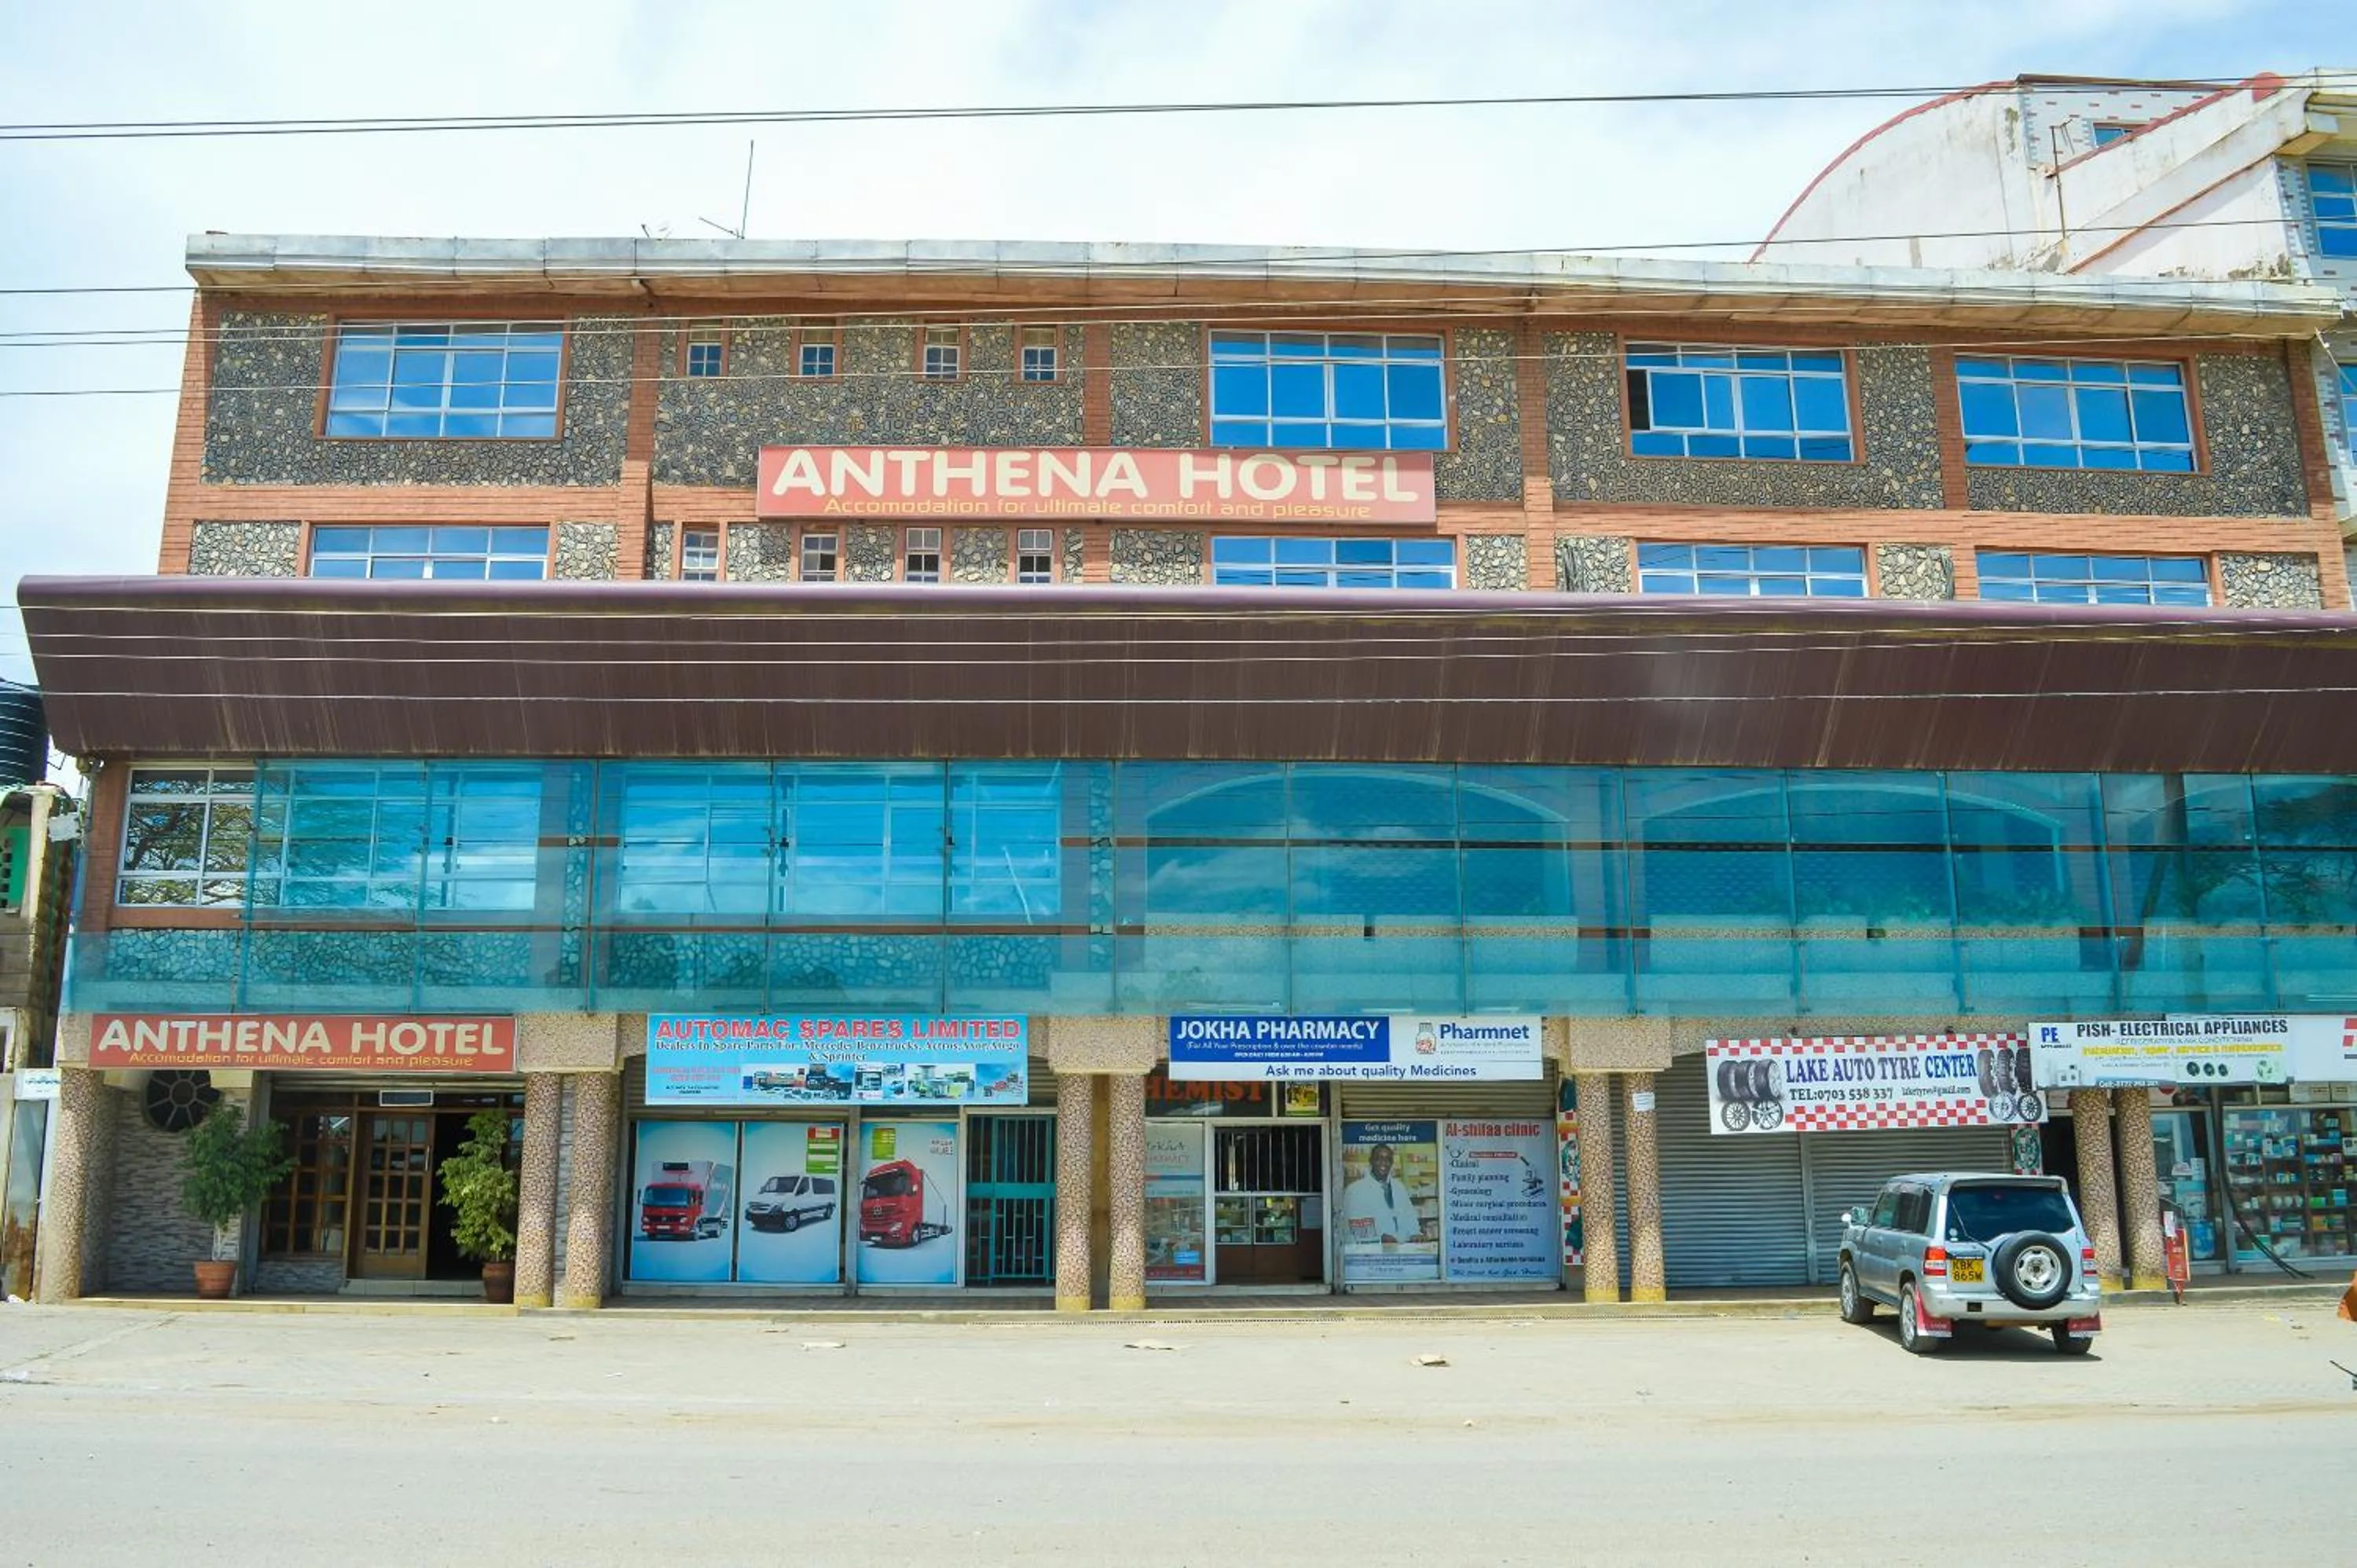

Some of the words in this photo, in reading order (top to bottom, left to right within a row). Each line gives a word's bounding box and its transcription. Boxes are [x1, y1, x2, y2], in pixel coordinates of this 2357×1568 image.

[772, 449, 1149, 499] ANTHENA
[1179, 453, 1419, 502] HOTEL
[823, 498, 989, 514] Accomodation
[997, 498, 1028, 515] for
[1035, 498, 1122, 515] ultimate
[1131, 500, 1211, 516] comfort
[1221, 500, 1264, 517] and
[1273, 500, 1372, 519] pleasure
[656, 1018, 790, 1039] AUTOMAC
[799, 1018, 903, 1039] SPARES
[911, 1018, 1021, 1039] LIMITED
[1177, 1020, 1251, 1040] JOKHA
[1257, 1020, 1380, 1039] PHARMACY
[1439, 1023, 1530, 1039] Pharmnet
[2040, 1027, 2059, 1043] PE
[2077, 1023, 2117, 1038] PISH-
[2121, 1020, 2201, 1037] ELECTRICAL
[2205, 1019, 2288, 1035] APPLIANCES
[98, 1020, 332, 1053] ANTHENA
[351, 1022, 505, 1055] HOTEL
[713, 1040, 743, 1053] Spare
[129, 1052, 232, 1064] Accomodation
[236, 1053, 254, 1064] for
[319, 1054, 371, 1066] comfort
[376, 1055, 404, 1067] and
[409, 1055, 474, 1068] pleasure
[809, 1052, 819, 1061] &
[823, 1051, 867, 1063] Sprinter
[1266, 1064, 1289, 1076] Ask
[1294, 1067, 1314, 1076] me
[1318, 1064, 1356, 1076] about
[1362, 1064, 1406, 1079] quality
[1411, 1064, 1477, 1077] Medicines
[1785, 1058, 1829, 1083] LAKE
[1832, 1057, 1876, 1082] AUTO
[1878, 1056, 1921, 1080] TYRE
[1925, 1053, 1978, 1079] CENTER
[1146, 1077, 1263, 1101] HEMIST
[1789, 1088, 1846, 1101] TEL:0703
[1849, 1087, 1871, 1100] 538
[1873, 1086, 1893, 1100] 337
[1365, 1123, 1380, 1131] Get
[1381, 1123, 1411, 1134] quality
[1446, 1122, 1501, 1137] Al-shifaa
[1505, 1122, 1541, 1137] clinic
[1952, 1259, 1974, 1270] KBK
[1953, 1270, 1982, 1281] 865W
